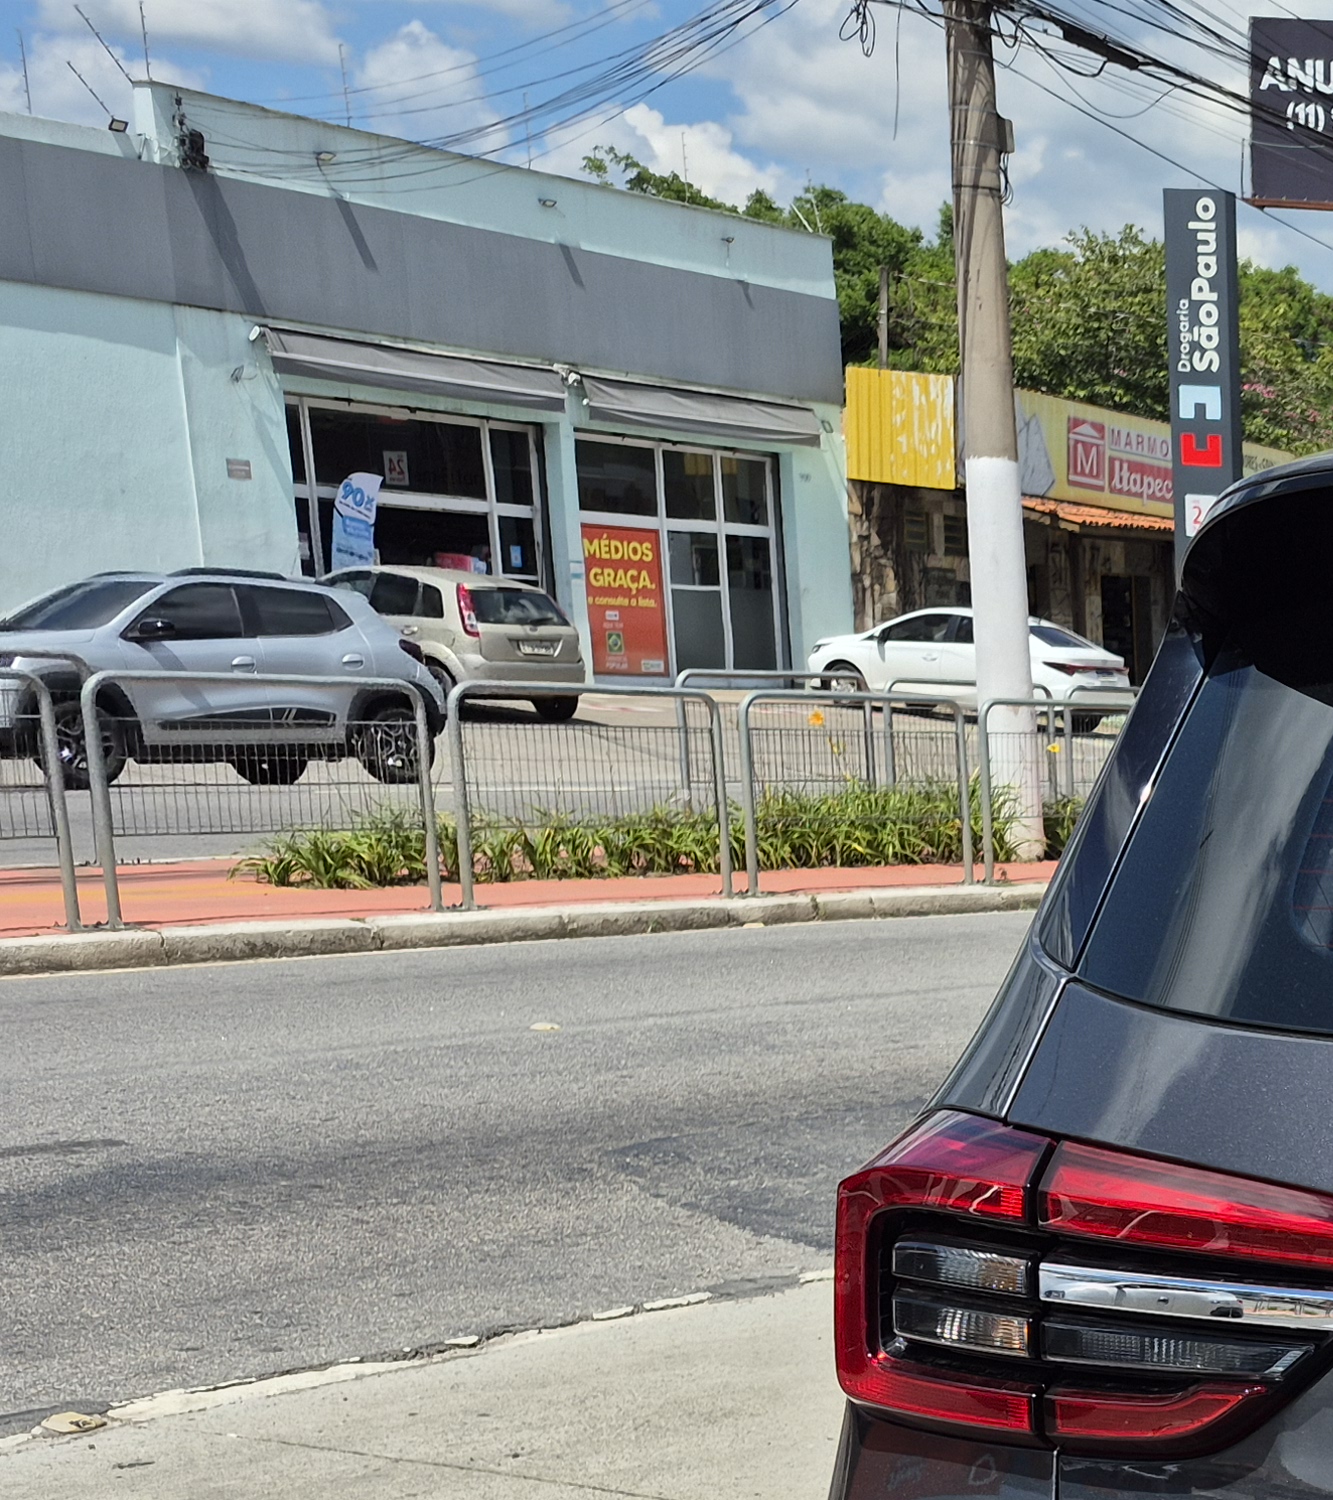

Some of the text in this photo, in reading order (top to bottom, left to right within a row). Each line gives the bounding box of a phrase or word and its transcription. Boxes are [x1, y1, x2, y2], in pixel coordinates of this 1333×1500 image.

[1285, 101, 1325, 132] (11)
[1176, 298, 1192, 373] Drogaria
[582, 533, 653, 562] MÉDIOS
[589, 567, 656, 595] GRAÇA.
